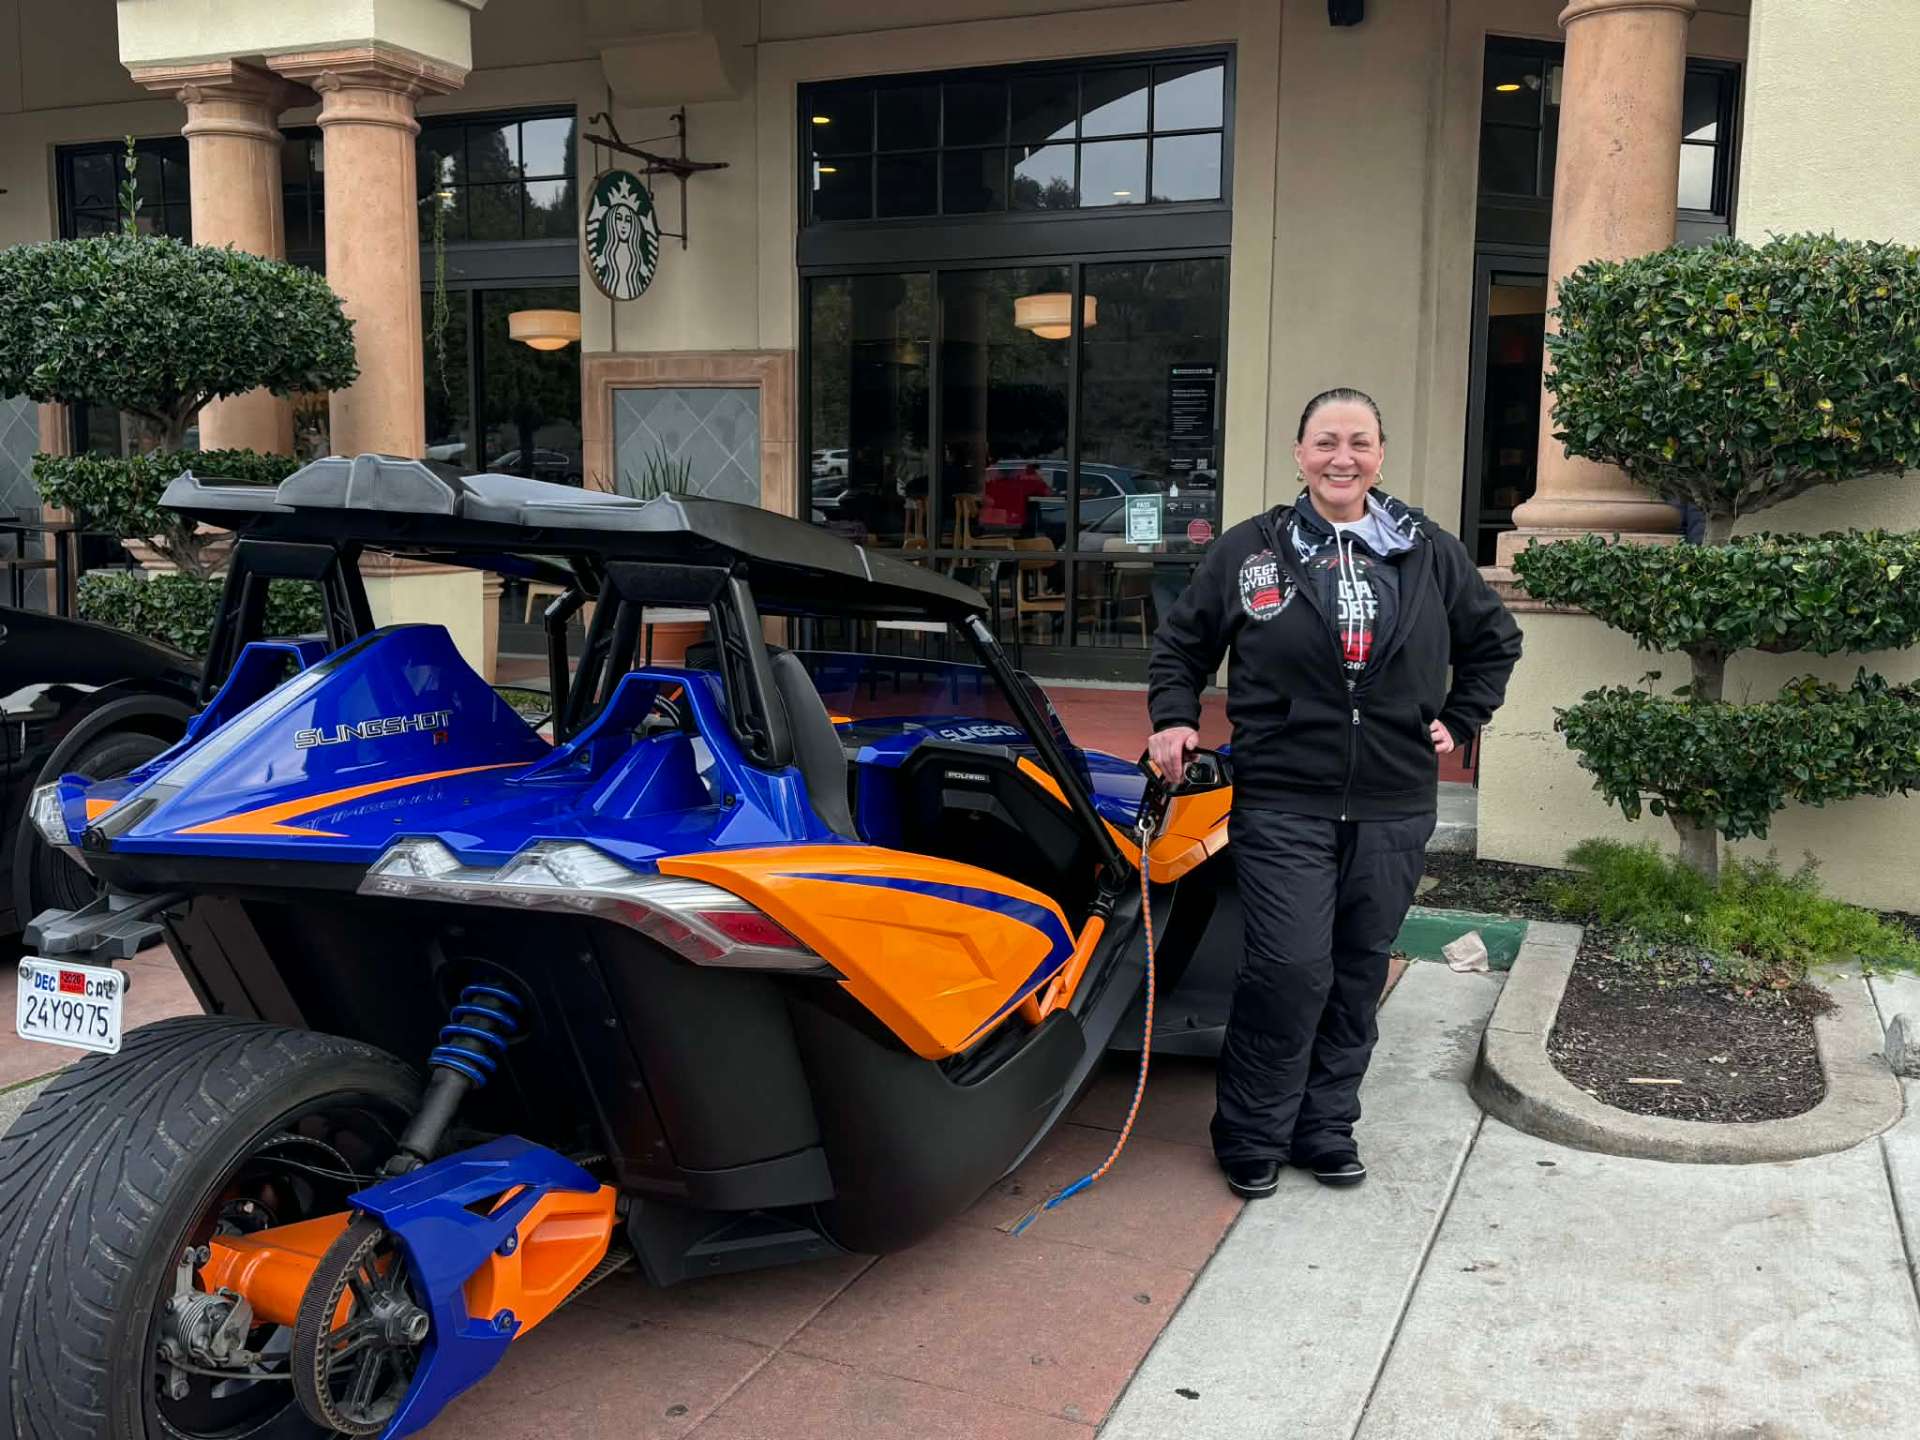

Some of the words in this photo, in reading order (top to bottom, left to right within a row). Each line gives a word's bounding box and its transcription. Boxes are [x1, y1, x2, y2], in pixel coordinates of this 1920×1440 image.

[1244, 562, 1279, 580] VEGA
[294, 709, 454, 750] SLINGSHOT
[947, 770, 987, 781] POLARIS
[34, 972, 56, 992] DEC
[26, 995, 109, 1037] 24Y9975
